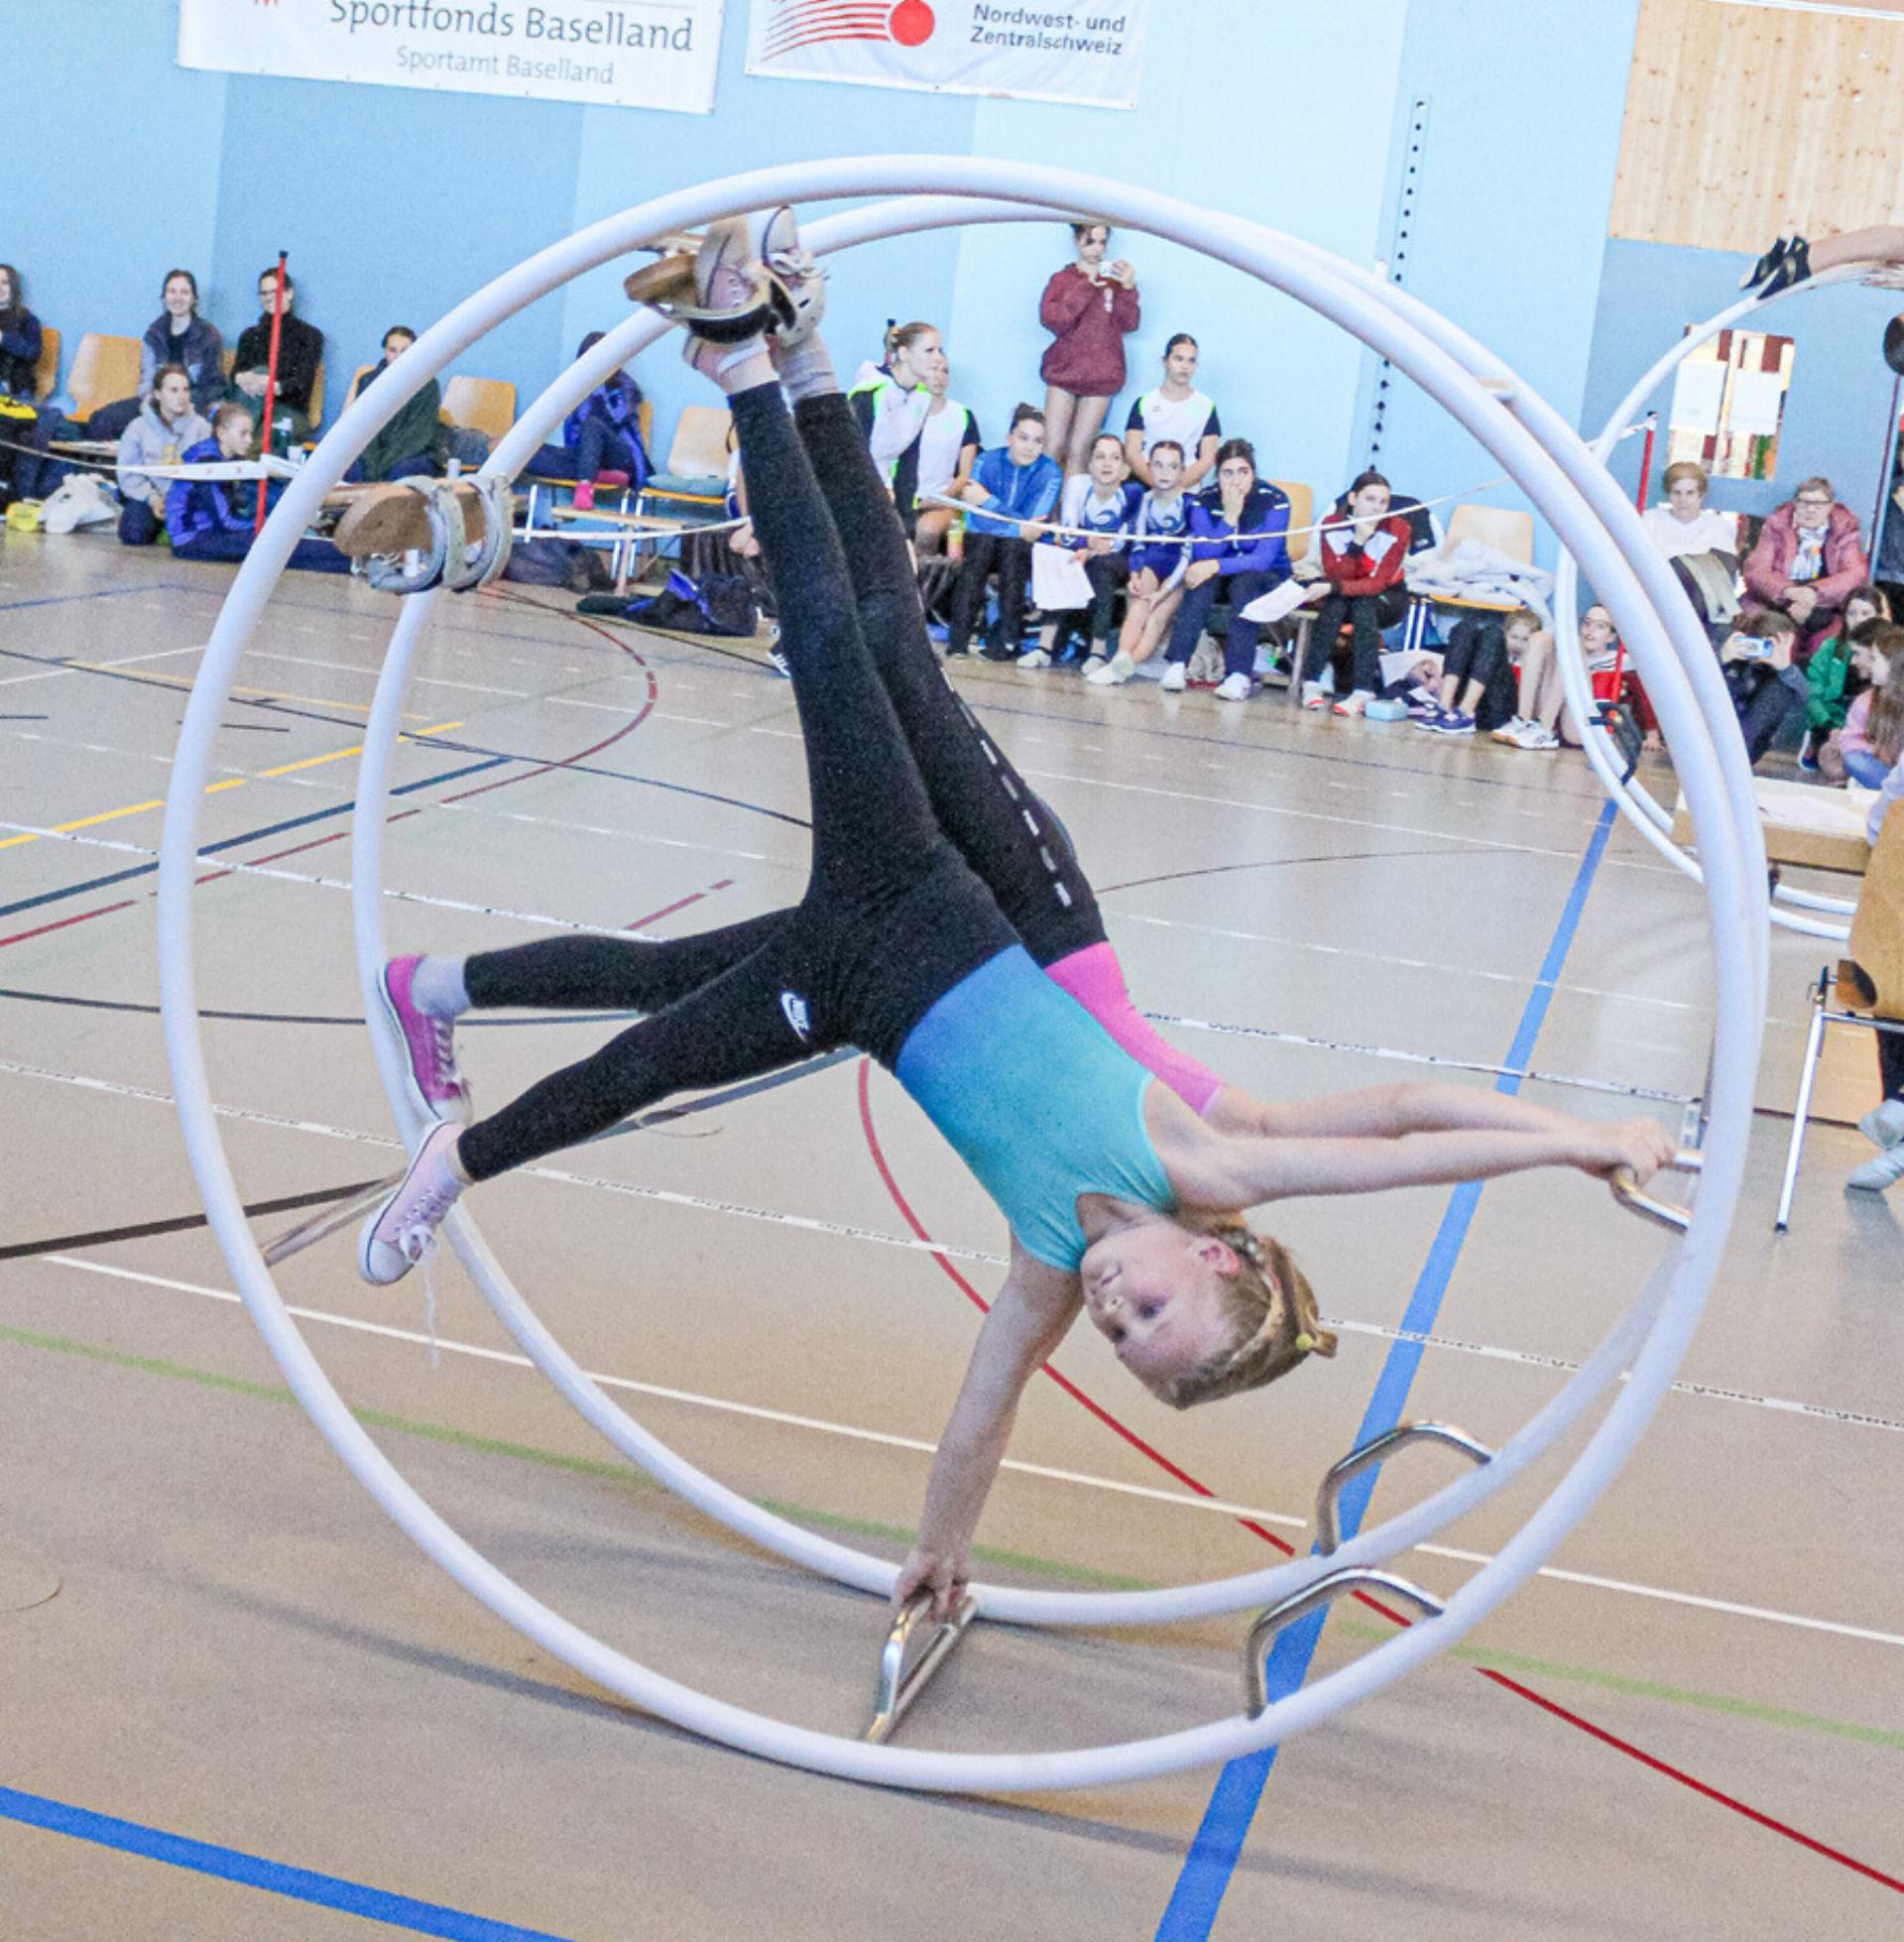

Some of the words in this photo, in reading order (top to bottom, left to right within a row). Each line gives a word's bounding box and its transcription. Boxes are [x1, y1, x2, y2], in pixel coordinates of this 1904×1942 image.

[330, 0, 515, 37] Sportfonds
[525, 7, 693, 52] Baselland
[973, 3, 1080, 30] Nordwest-
[1086, 16, 1127, 33] und
[970, 25, 1124, 56] Zentralschweiz
[397, 46, 499, 73] Sportamt
[507, 55, 614, 84] Baselland
